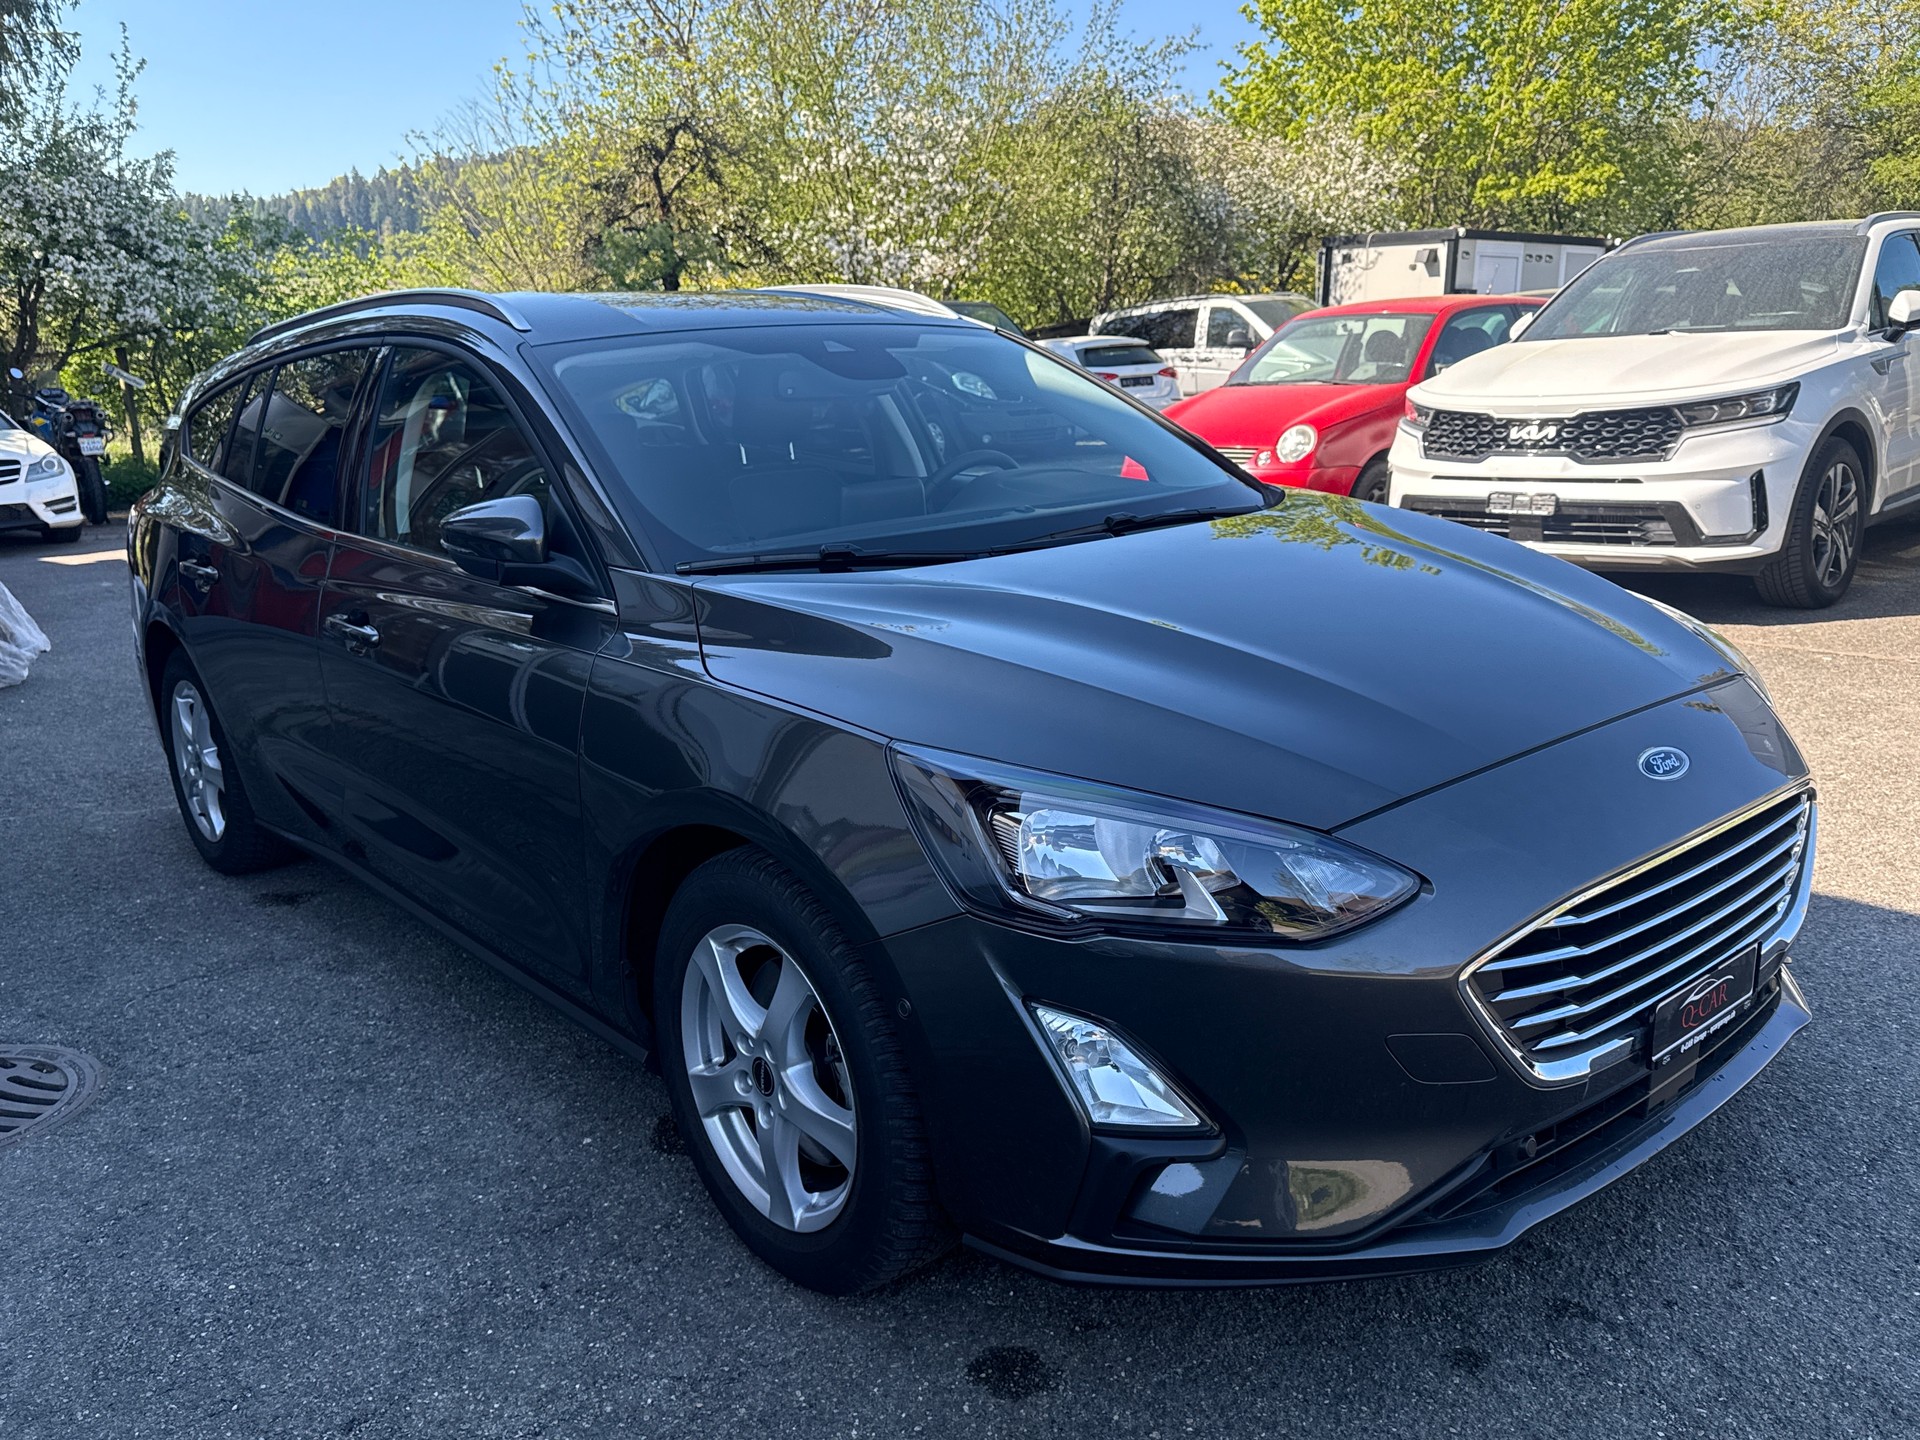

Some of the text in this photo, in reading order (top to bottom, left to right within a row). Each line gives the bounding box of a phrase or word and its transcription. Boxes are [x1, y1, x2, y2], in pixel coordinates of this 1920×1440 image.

[1509, 425, 1557, 440] KIA
[1650, 753, 1680, 773] Ford
[1682, 984, 1727, 1028] Q-CAR
